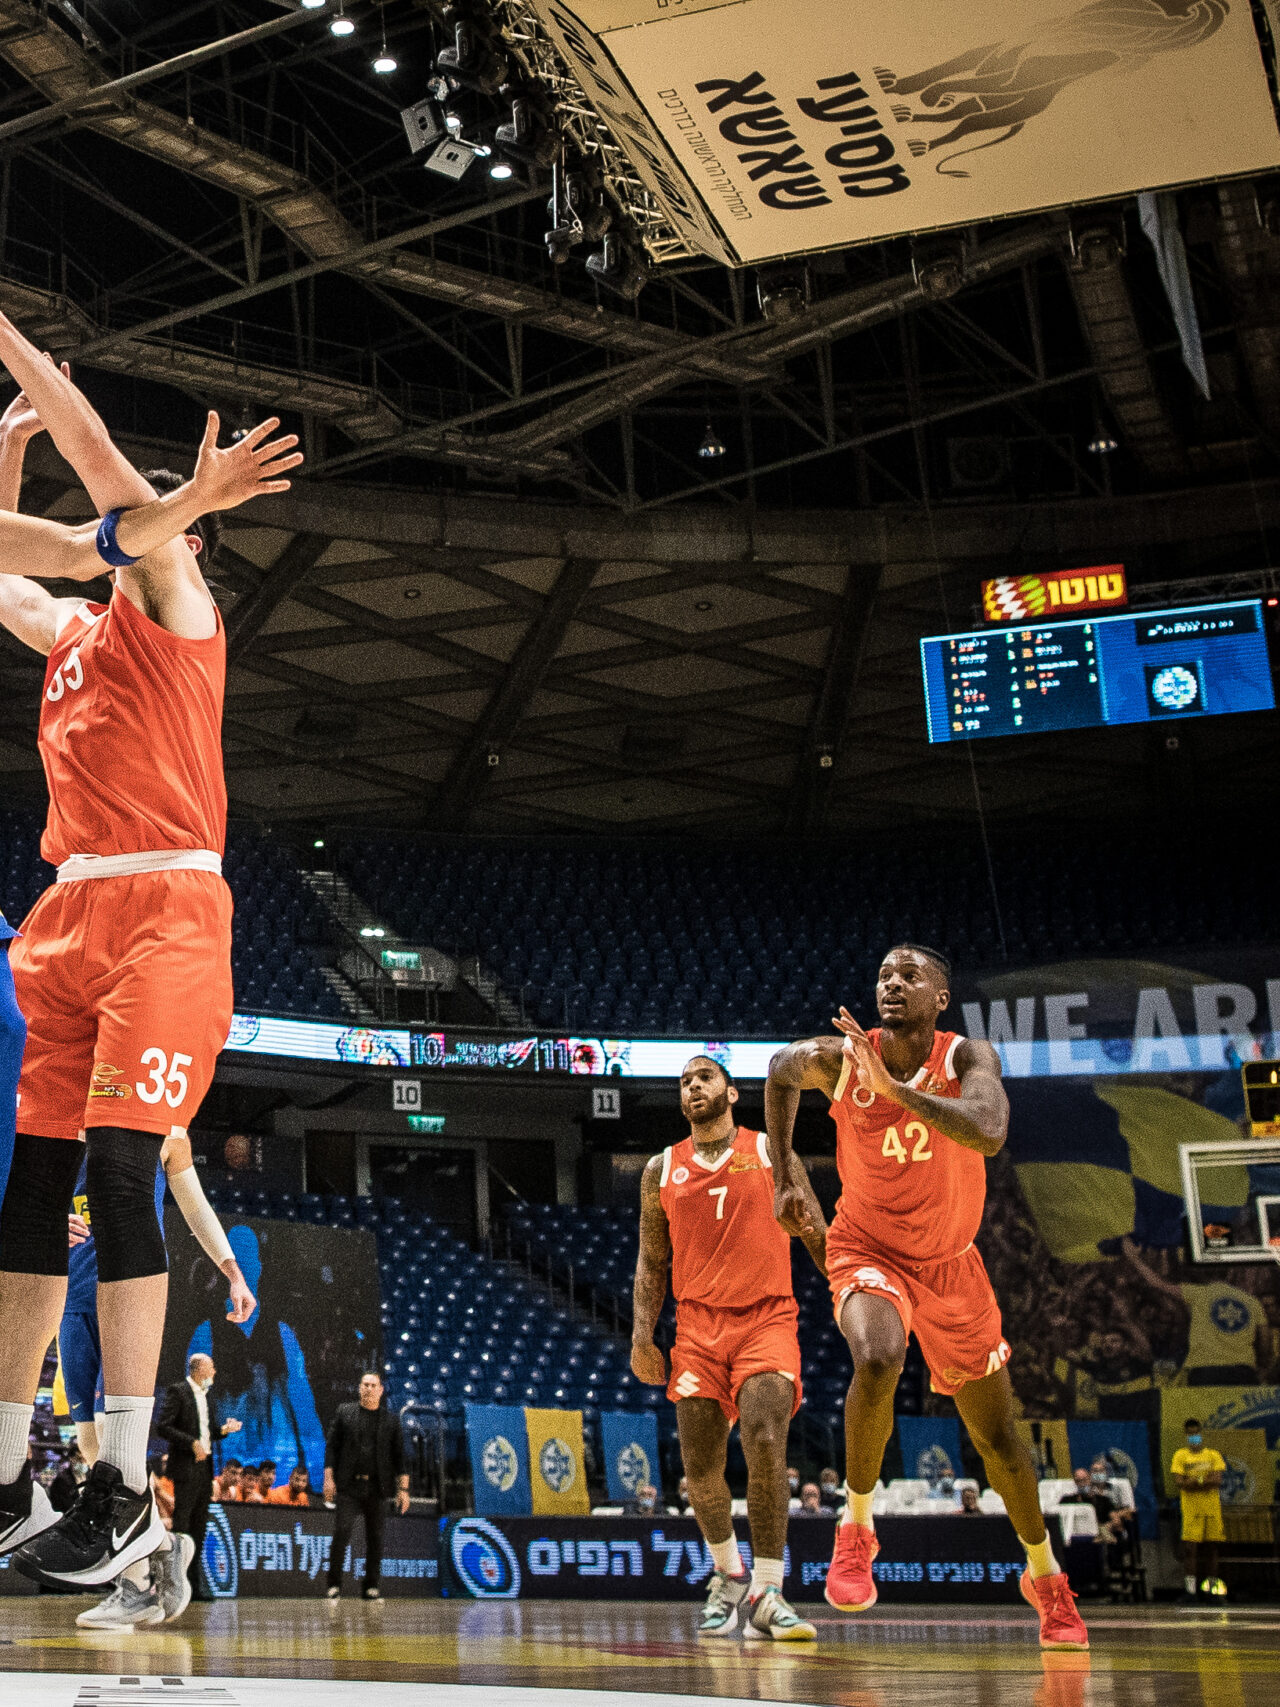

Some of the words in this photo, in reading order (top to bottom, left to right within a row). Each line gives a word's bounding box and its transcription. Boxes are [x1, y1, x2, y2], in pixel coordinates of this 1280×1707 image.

[657, 88, 697, 131] בדרכים
[683, 130, 726, 178] הראשונה
[695, 69, 833, 211] שאשא
[796, 71, 912, 198] מסיעי
[711, 178, 753, 221] המחלקה
[1047, 572, 1124, 606] טוטו
[962, 992, 1097, 1078] WE
[1131, 978, 1280, 1070] AR
[135, 1047, 193, 1109] 35
[396, 1086, 418, 1105] 10
[599, 1094, 616, 1114] 11
[882, 1121, 933, 1164] 42
[708, 1186, 728, 1220] 7
[239, 1529, 293, 1571] הפיס
[527, 1537, 644, 1577] הפיס
